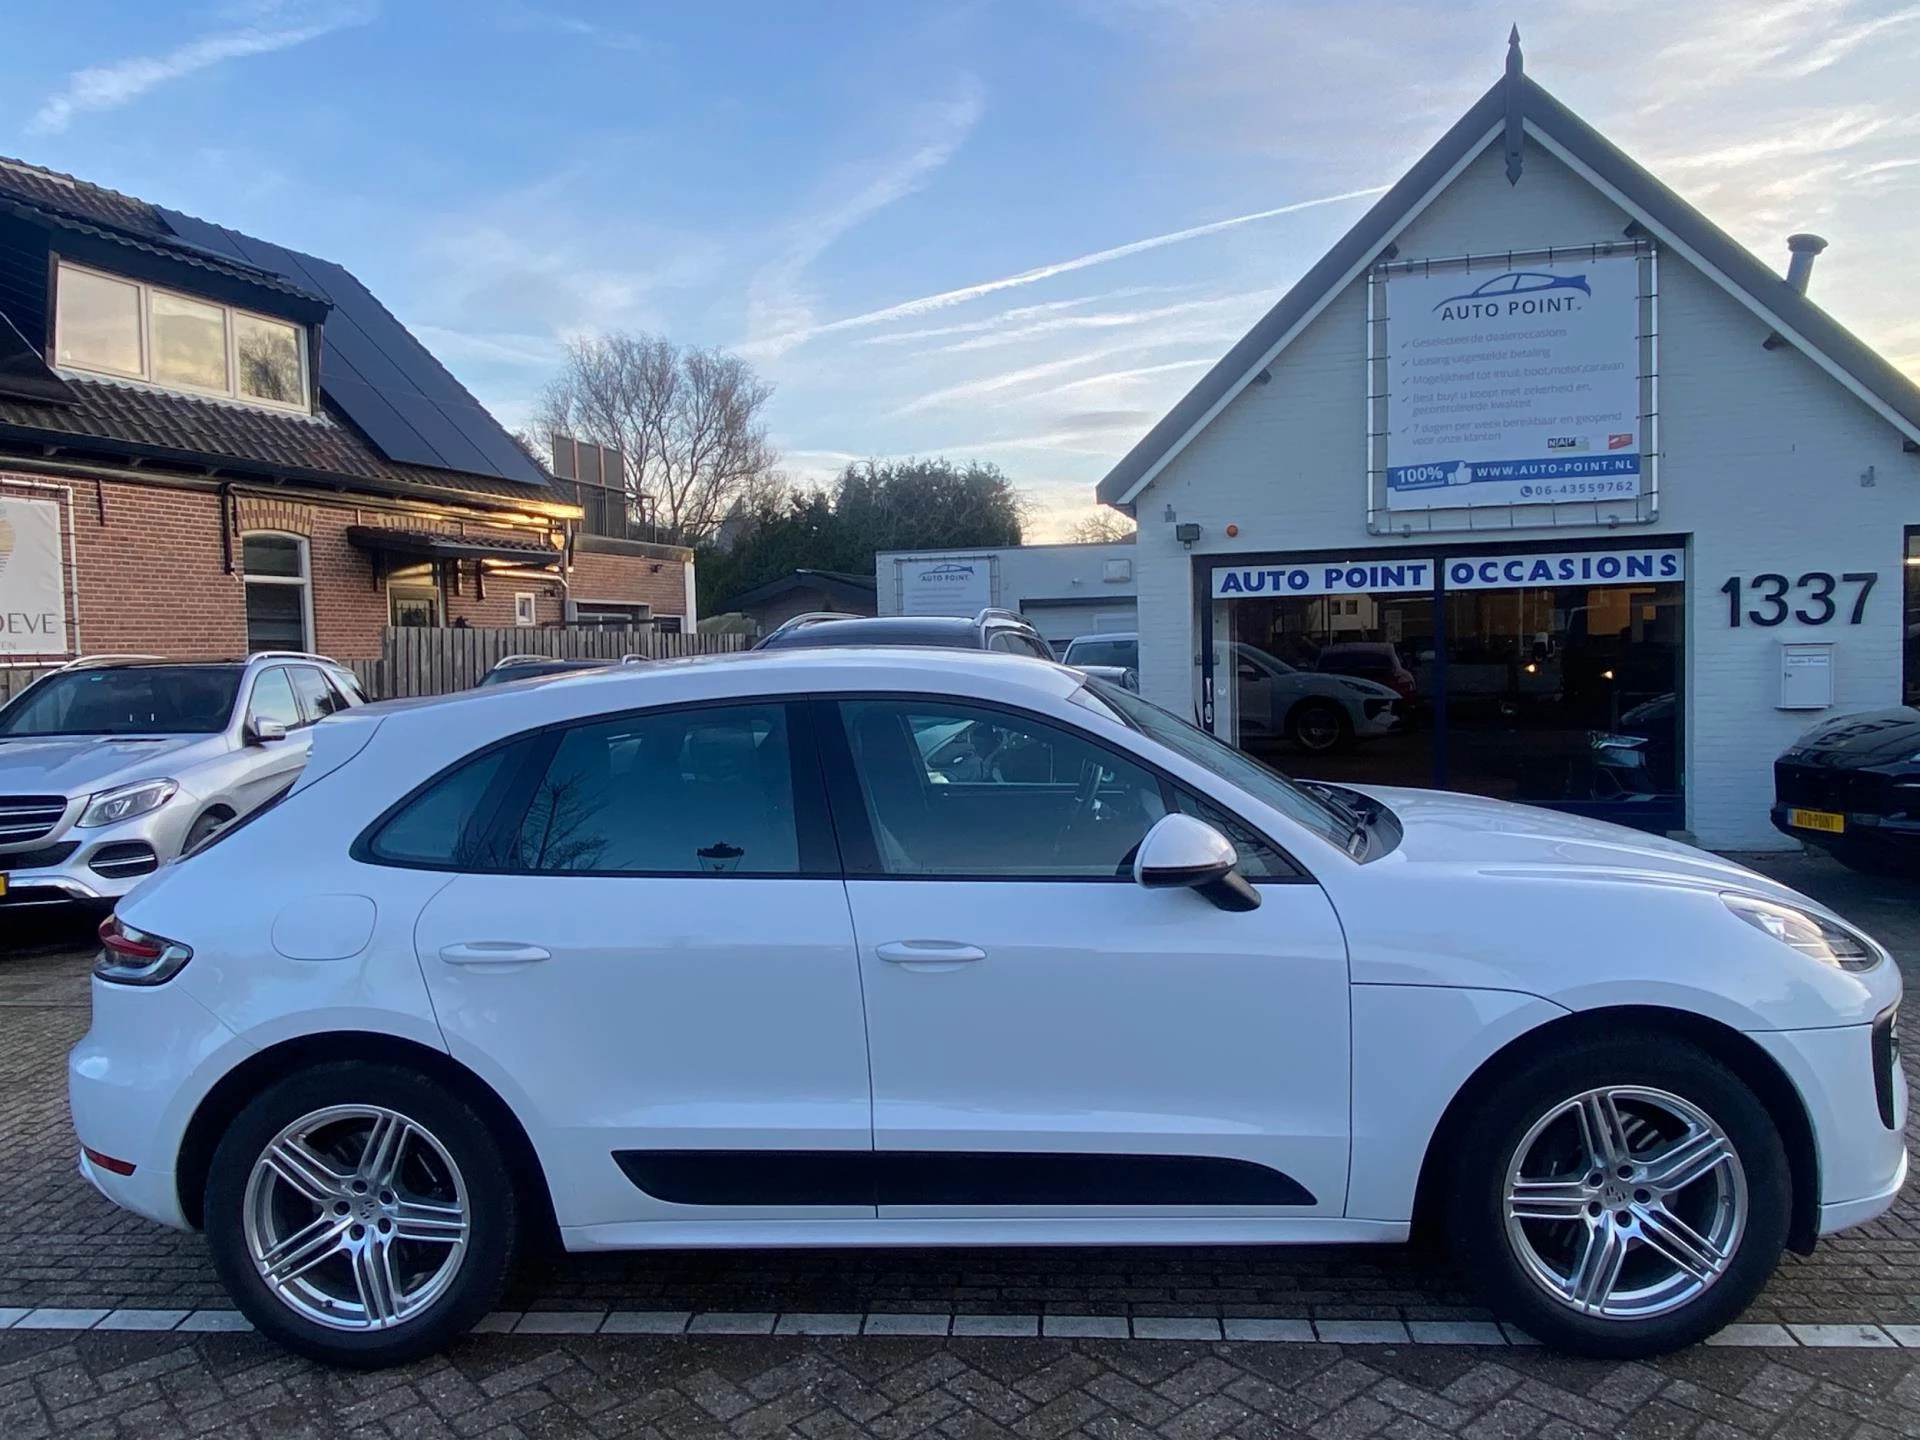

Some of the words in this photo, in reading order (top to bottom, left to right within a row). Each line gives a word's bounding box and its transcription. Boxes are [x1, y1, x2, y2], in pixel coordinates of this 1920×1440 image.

[1441, 303, 1499, 321] AUTO
[1510, 347, 1552, 359] betaling
[1476, 370, 1492, 381] tot
[1469, 388, 1498, 401] koopt
[1523, 384, 1574, 396] zekerheid
[1413, 423, 1420, 433] 7
[1421, 421, 1453, 435] dagen
[1454, 421, 1473, 433] per
[1559, 416, 1574, 424] en
[1575, 411, 1622, 425] geopend
[1397, 466, 1444, 484] 100%
[1477, 458, 1633, 477] WWW.AUTO-POINT.NL
[1535, 481, 1633, 496] 06-43559762
[922, 574, 943, 582] AUTO
[1220, 570, 1310, 594] AUTO
[1324, 564, 1428, 589] POINT
[1450, 553, 1678, 585] OCCASIONS
[1721, 572, 1879, 628] 1337
[0, 612, 57, 635] EVE
